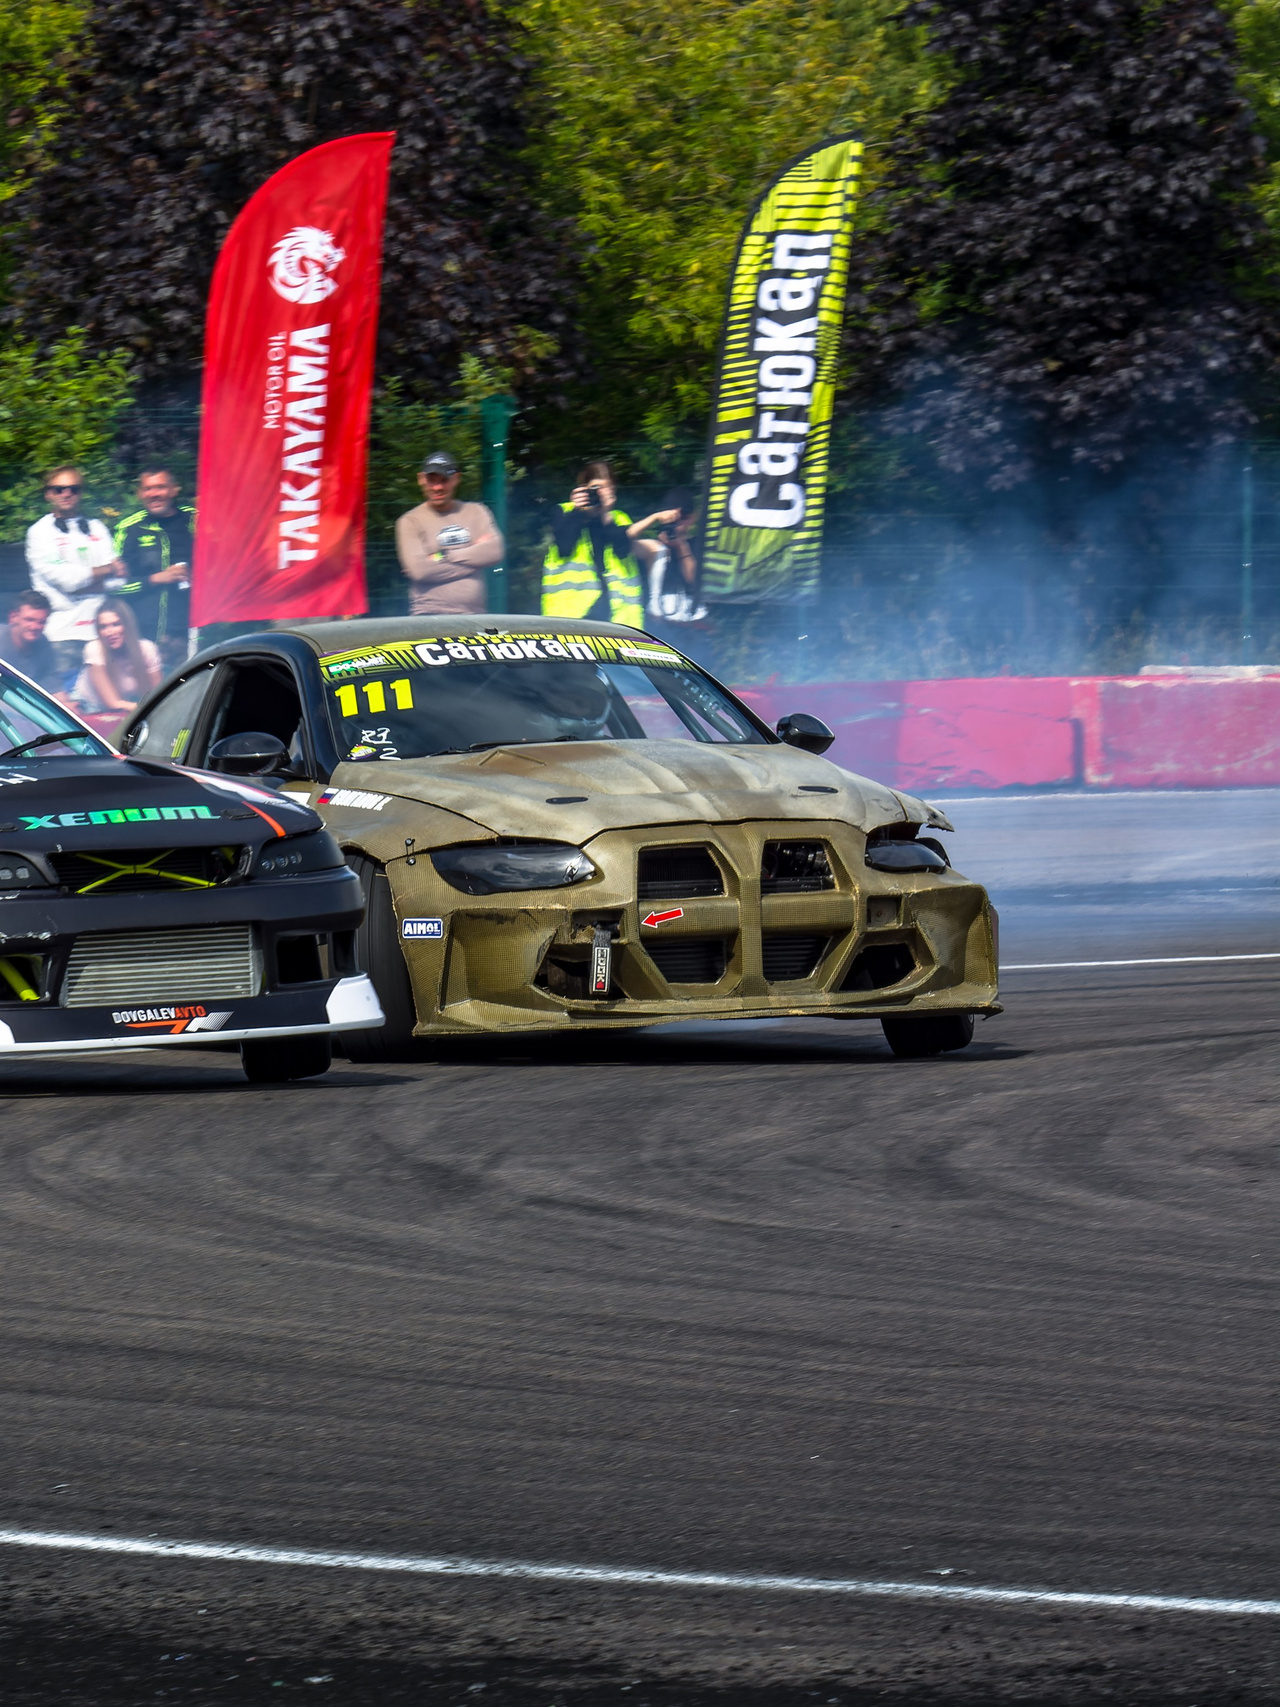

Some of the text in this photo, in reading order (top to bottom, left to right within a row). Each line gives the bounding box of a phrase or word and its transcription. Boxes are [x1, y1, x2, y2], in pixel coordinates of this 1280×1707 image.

[262, 365, 284, 430] MOTOR
[277, 323, 331, 569] TAKAYAMA
[334, 678, 414, 718] 111
[405, 923, 440, 934] AIMOL
